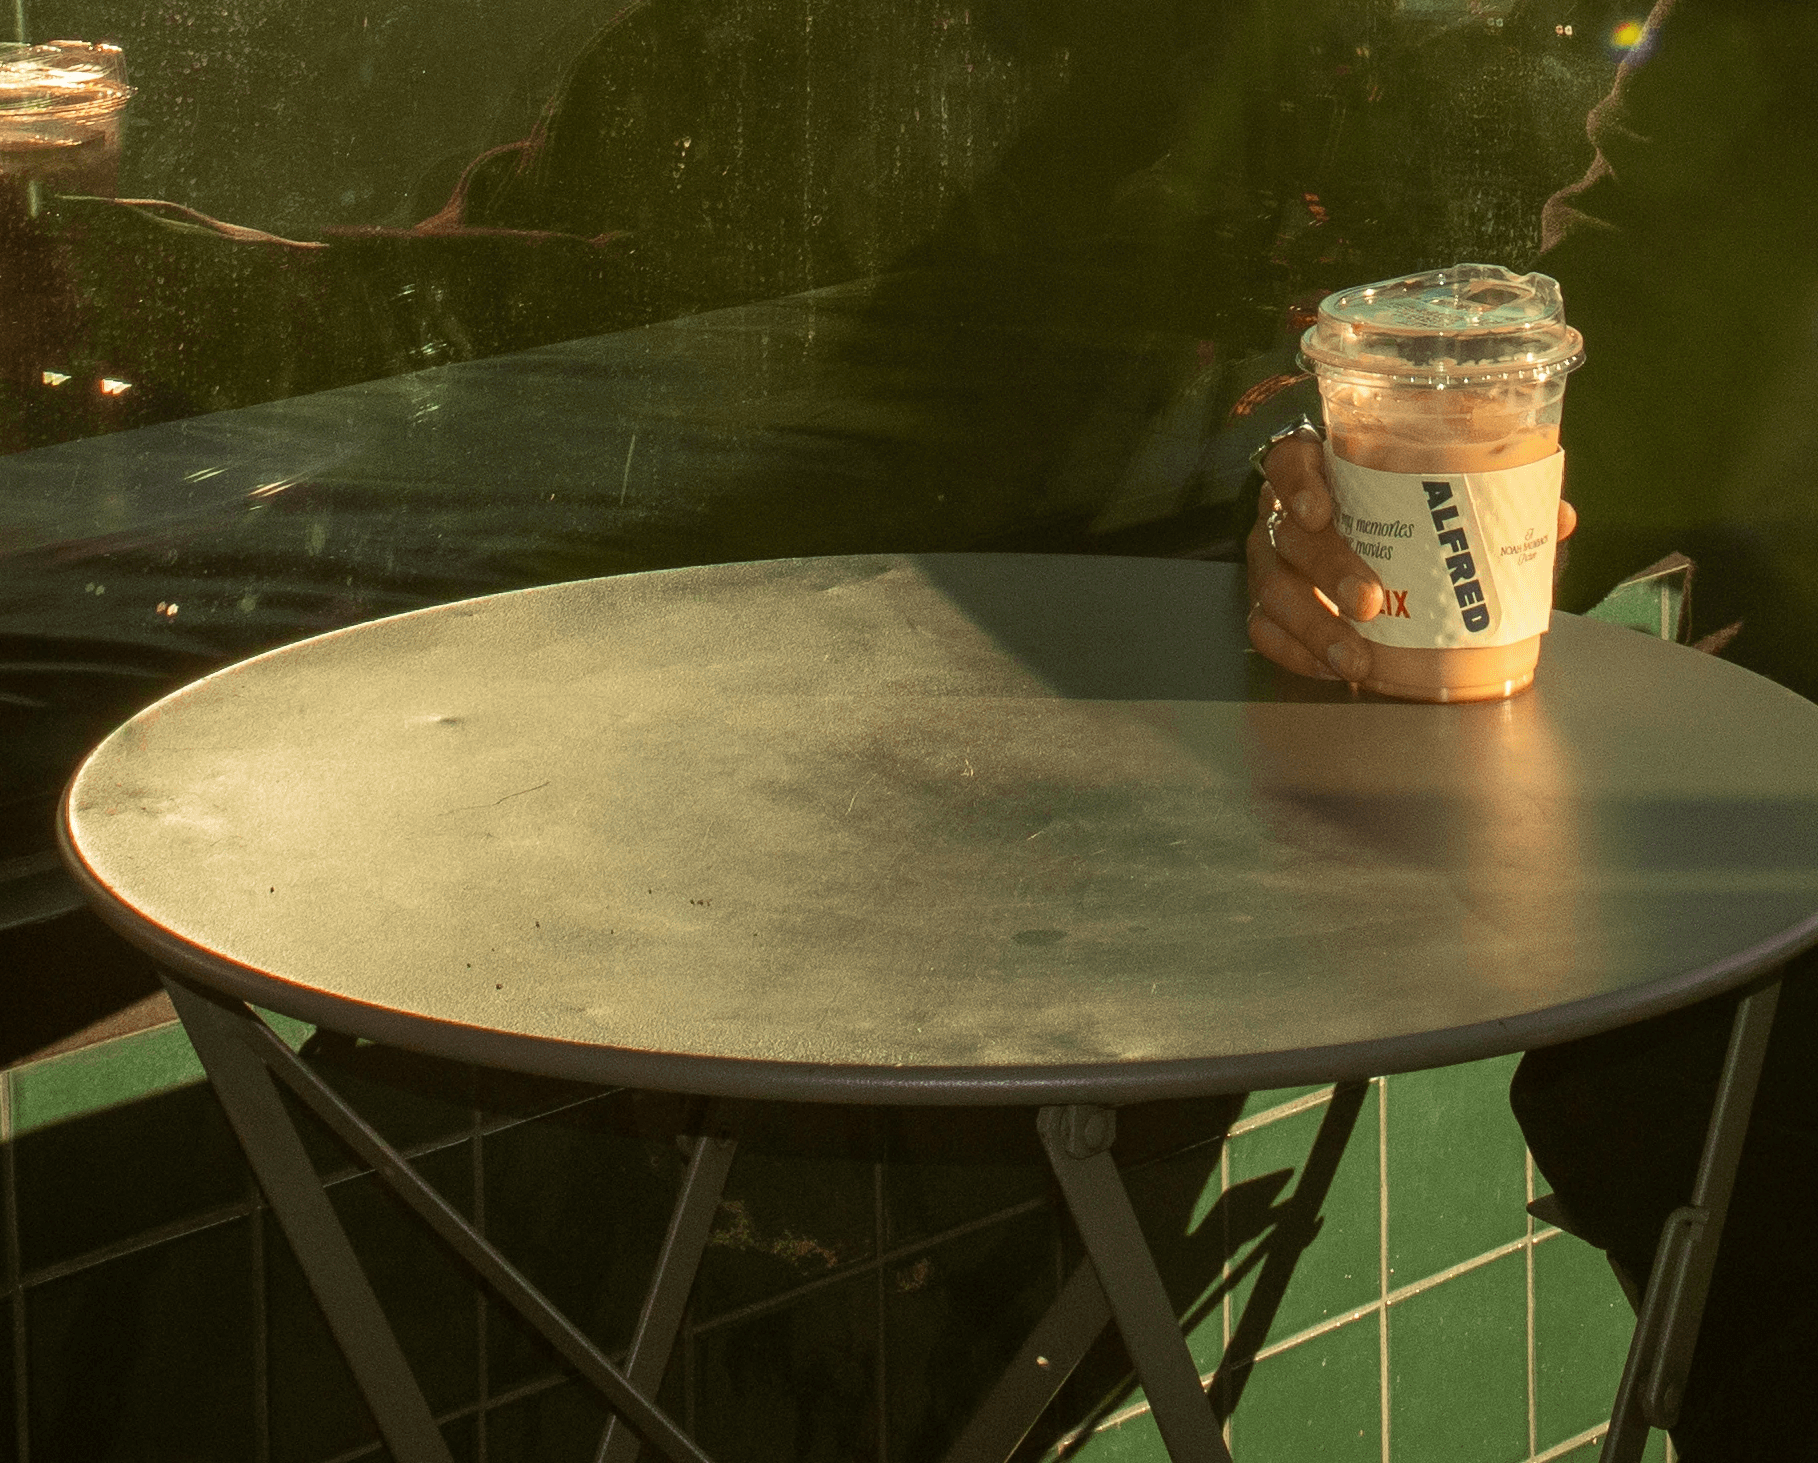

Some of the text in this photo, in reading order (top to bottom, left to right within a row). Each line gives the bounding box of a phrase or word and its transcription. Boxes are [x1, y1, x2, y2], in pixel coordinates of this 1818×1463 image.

[1355, 518, 1415, 539] memories
[1355, 540, 1394, 561] movies
[1422, 481, 1490, 633] ALFRED
